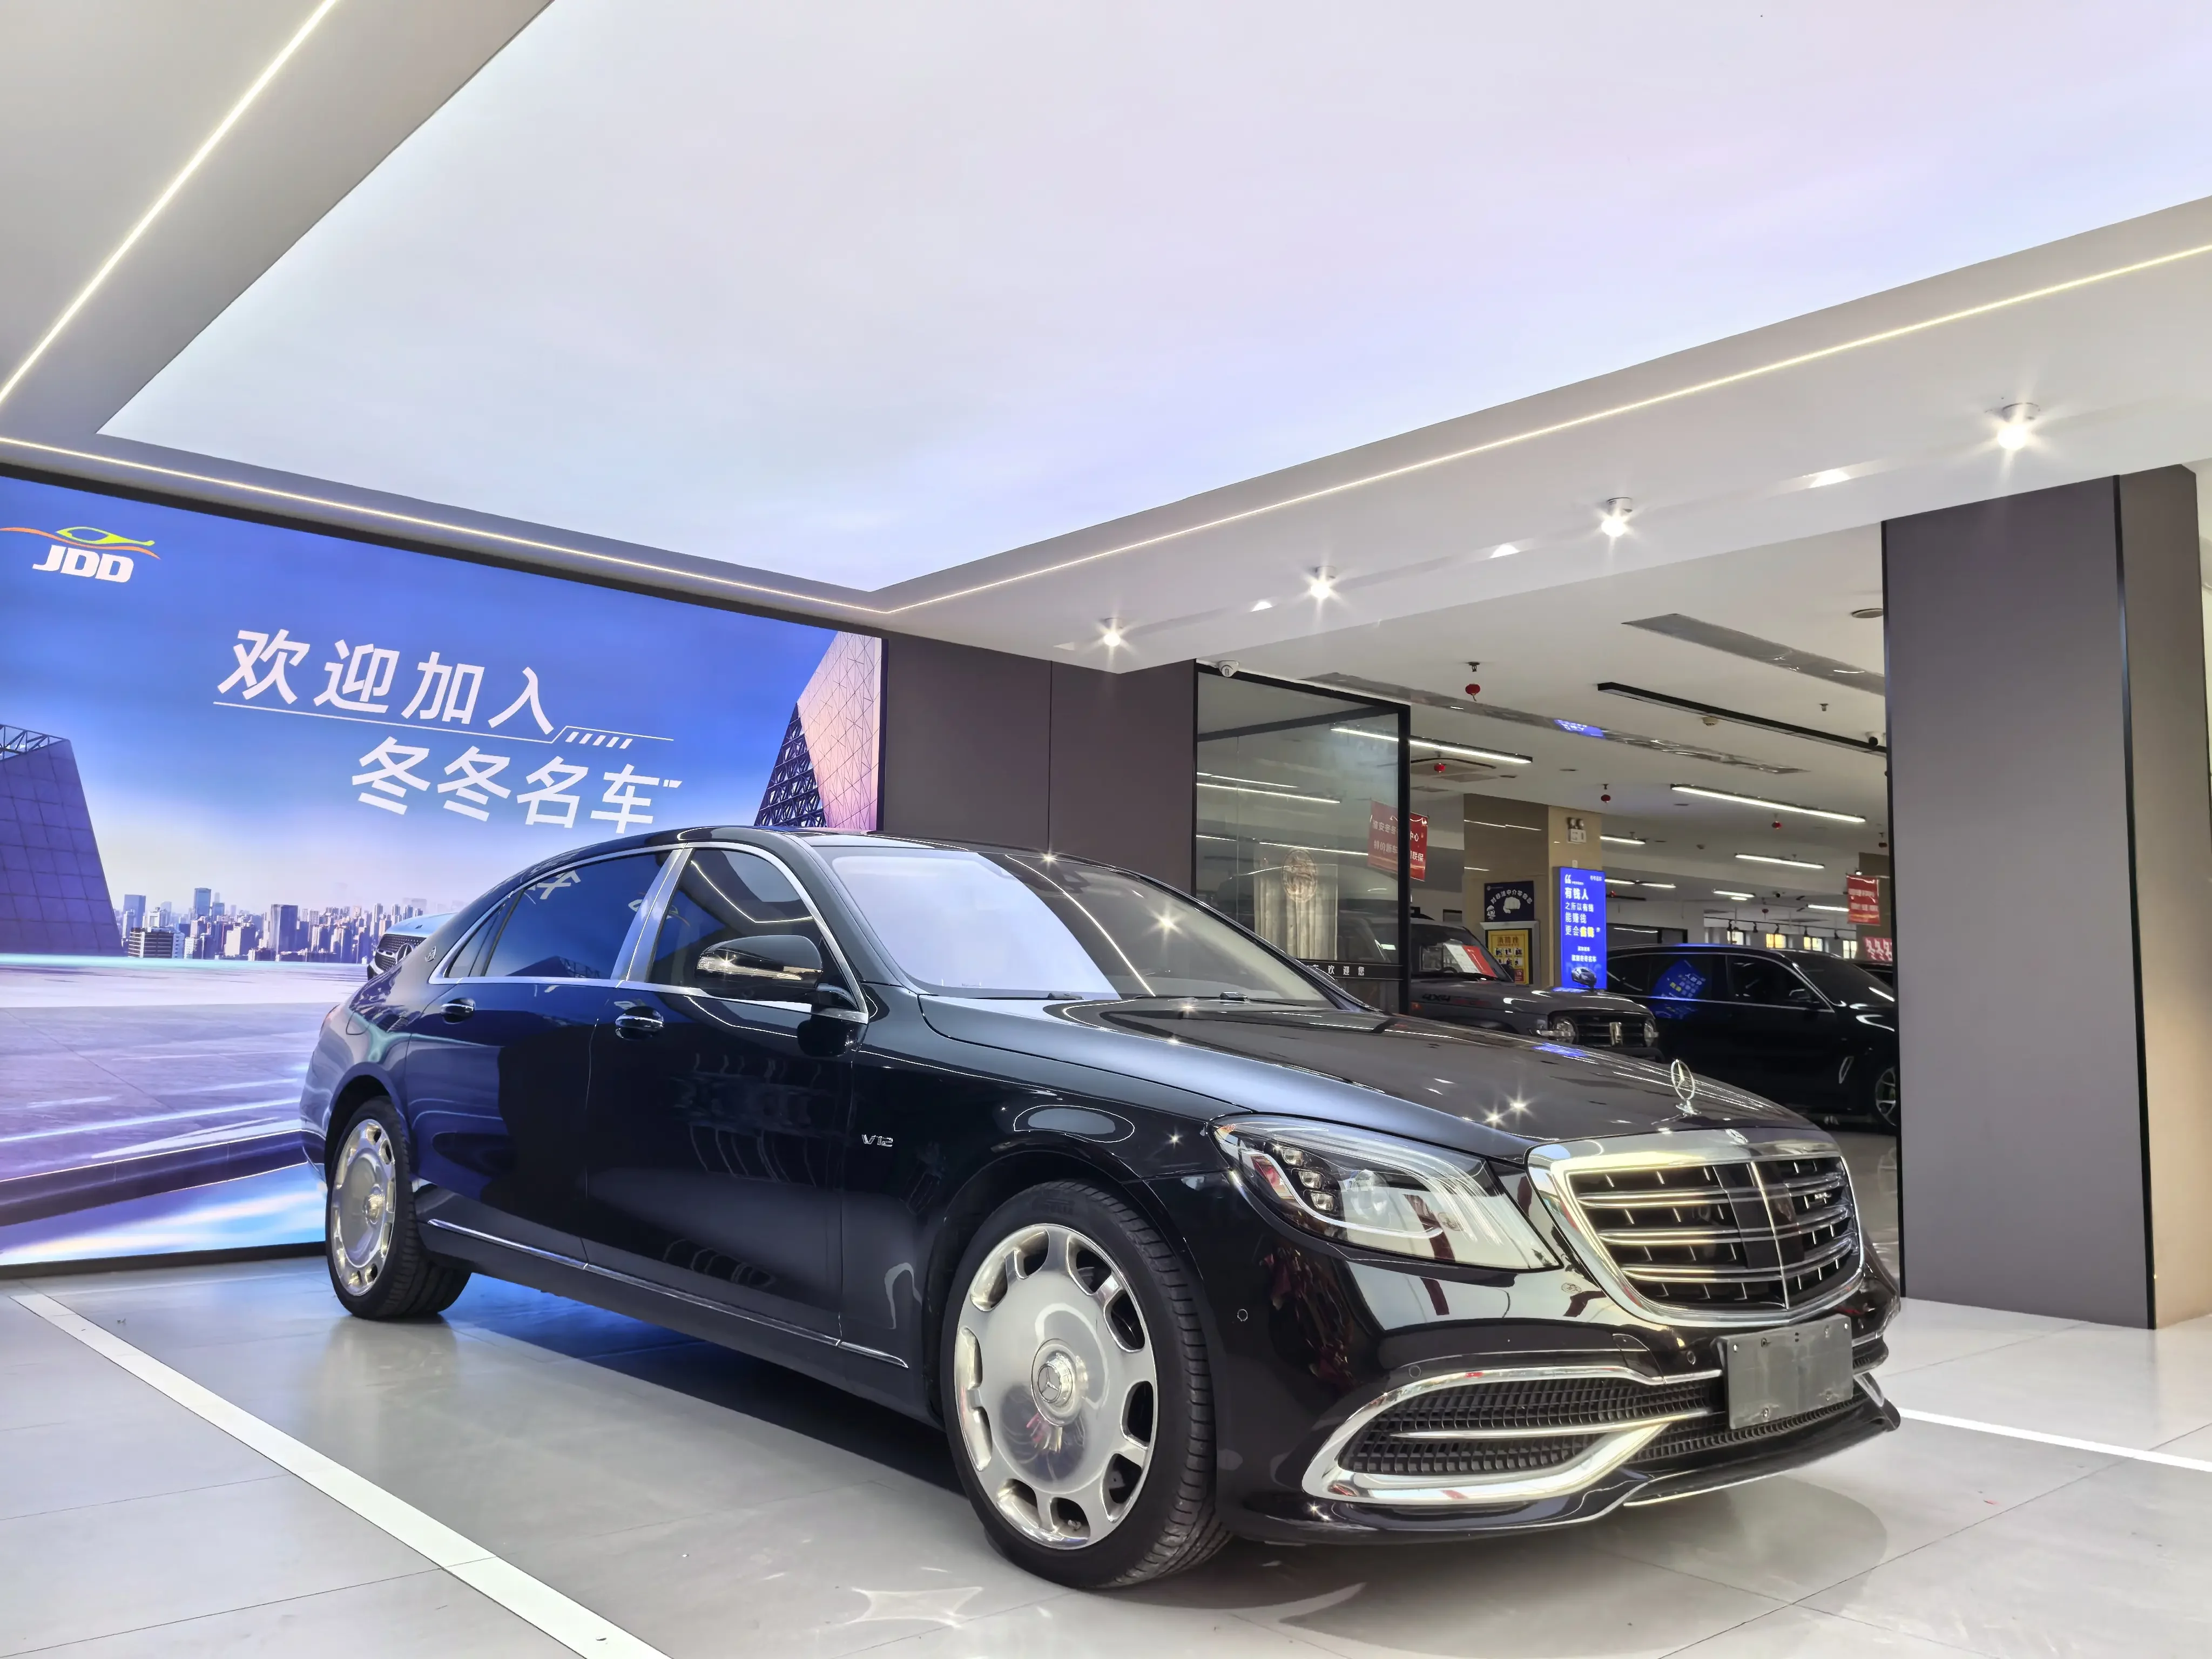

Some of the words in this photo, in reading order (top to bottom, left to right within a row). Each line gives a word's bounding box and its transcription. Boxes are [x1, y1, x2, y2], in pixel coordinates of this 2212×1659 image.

[32, 544, 134, 583] JDD
[217, 629, 554, 735] 欢迎加入
[352, 737, 661, 834] 冬冬名车
[1313, 964, 1365, 976] 欢迎您
[862, 1134, 893, 1147] V12
